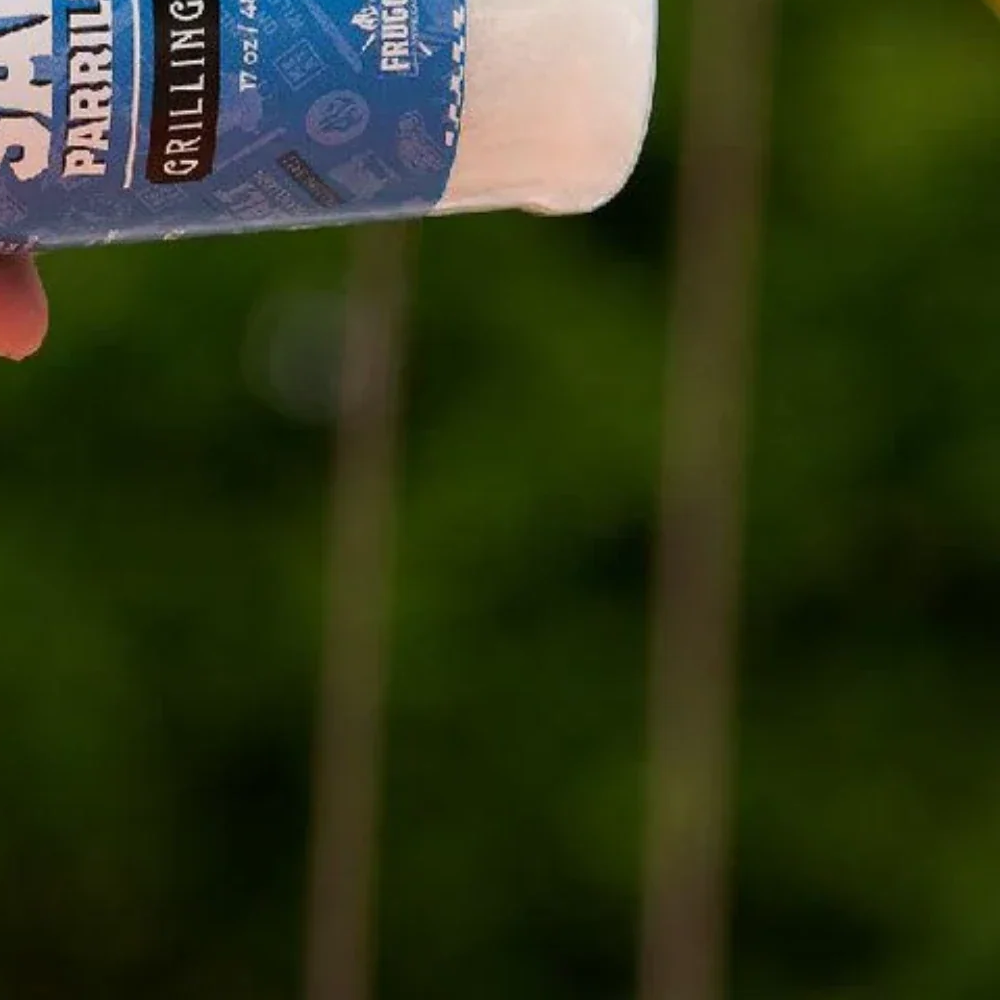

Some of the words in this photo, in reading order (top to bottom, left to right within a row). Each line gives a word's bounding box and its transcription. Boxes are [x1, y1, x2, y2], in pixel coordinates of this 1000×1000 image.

[243, 39, 258, 66] oz
[163, 1, 204, 179] GRILLING
[239, 71, 257, 93] 17
